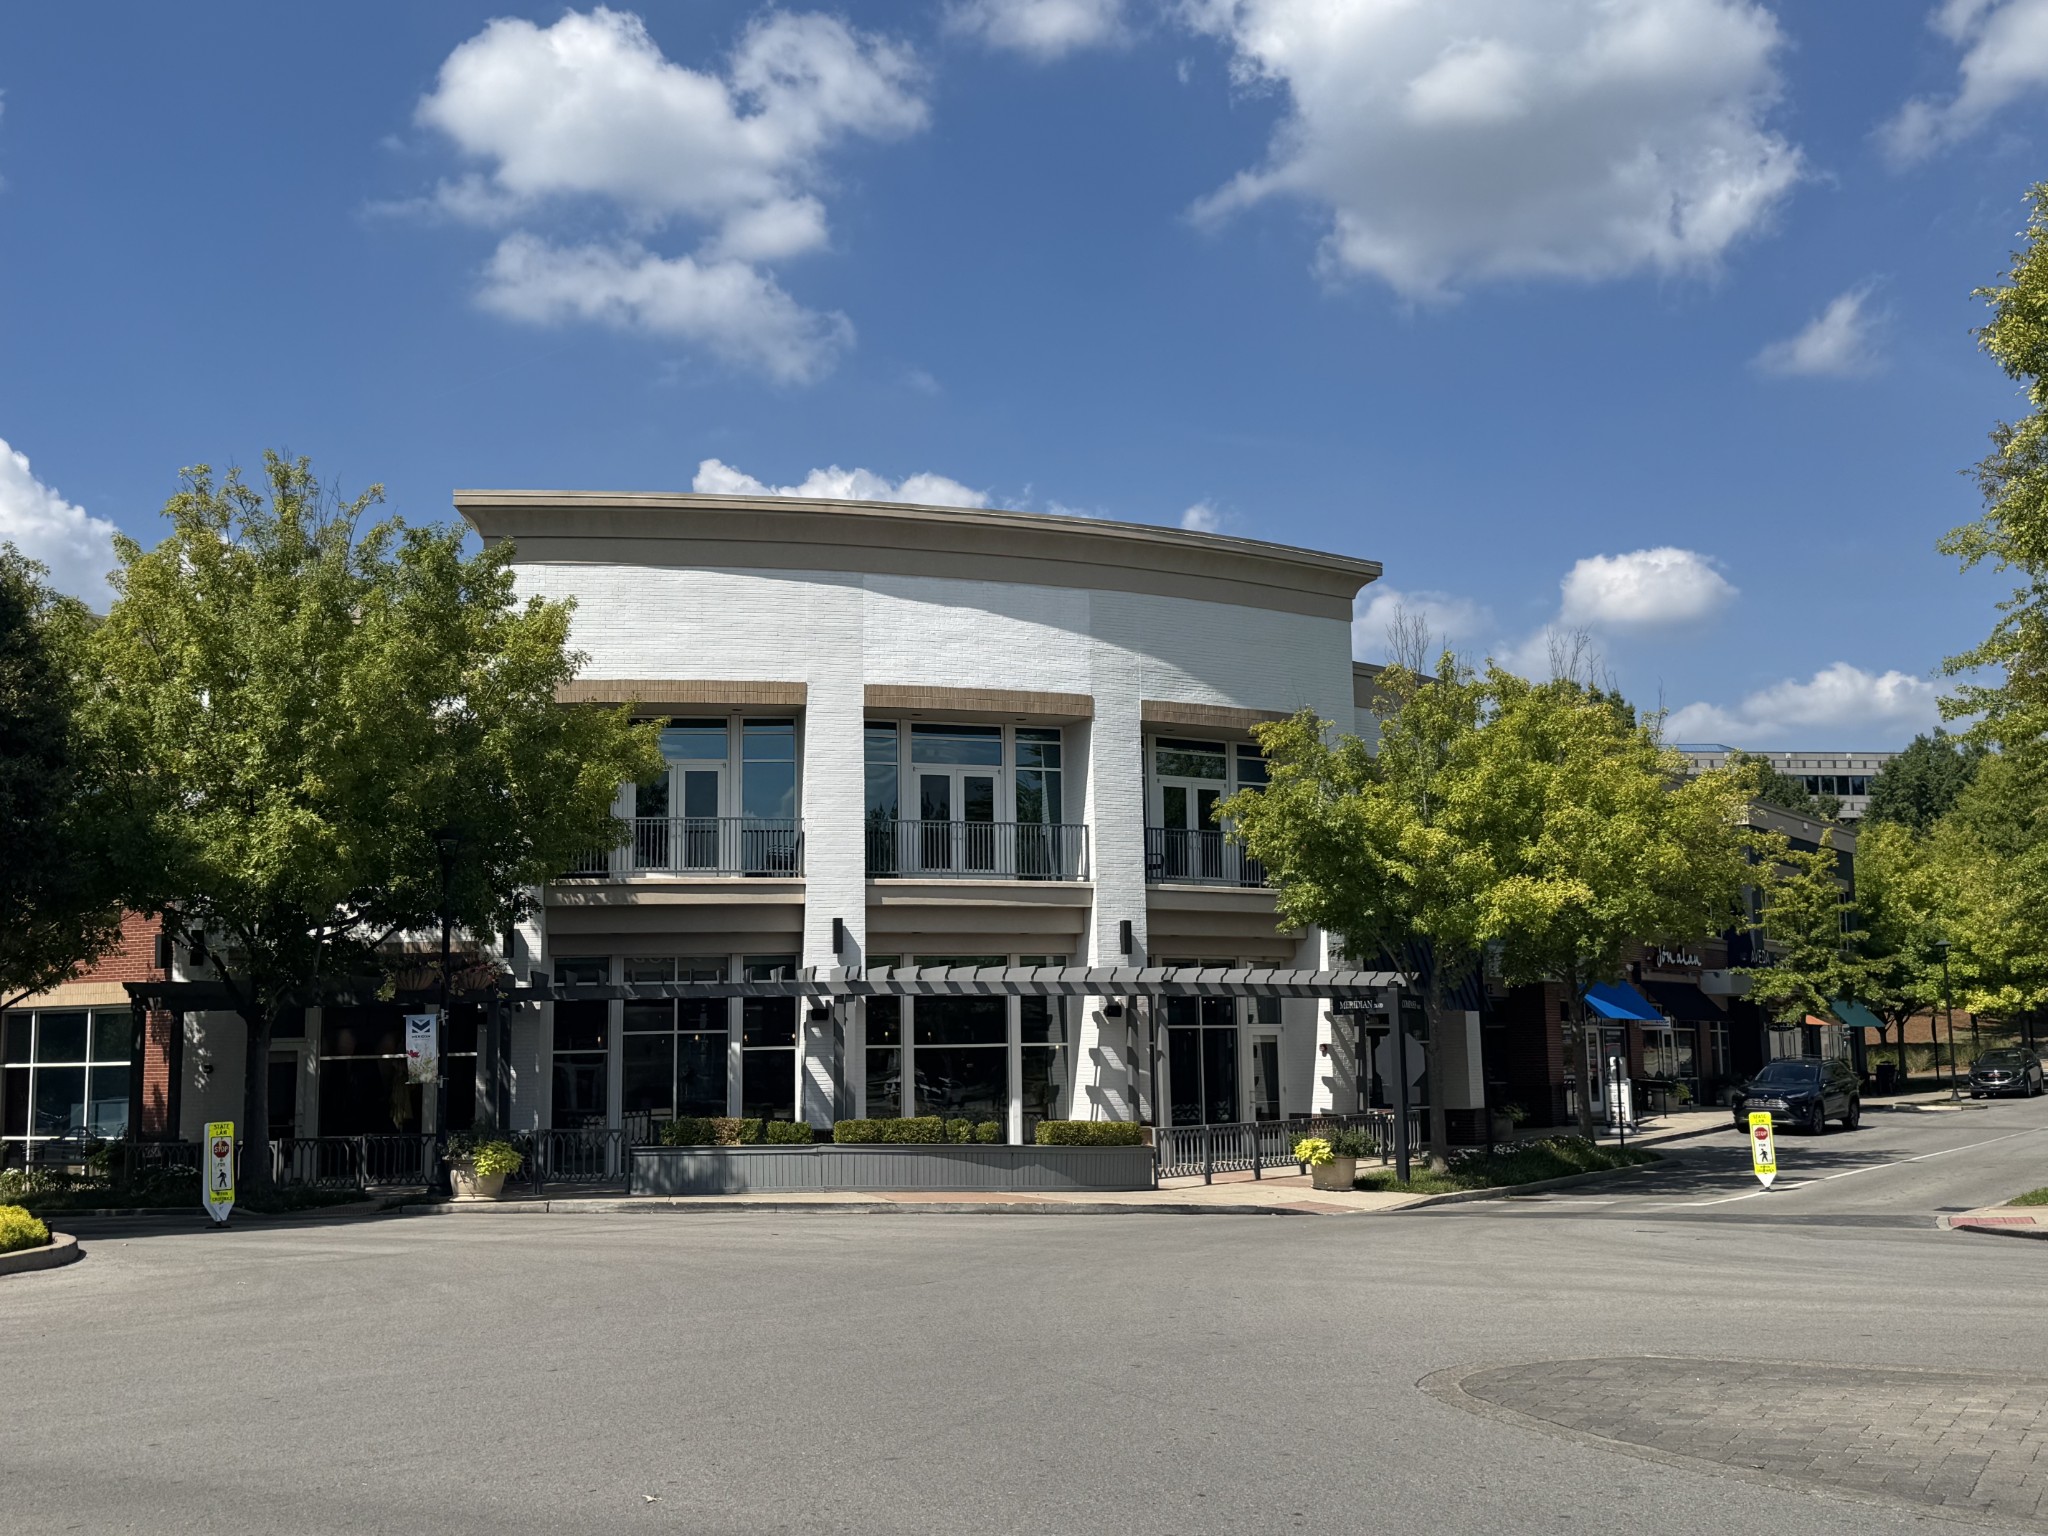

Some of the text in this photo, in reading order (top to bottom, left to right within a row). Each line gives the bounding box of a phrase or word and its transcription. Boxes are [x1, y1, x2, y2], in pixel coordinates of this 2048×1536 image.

[1676, 947, 1702, 967] alan
[1750, 949, 1771, 965] AVEDA
[1339, 999, 1373, 1010] MERIDIAN
[214, 1145, 228, 1153] STOP
